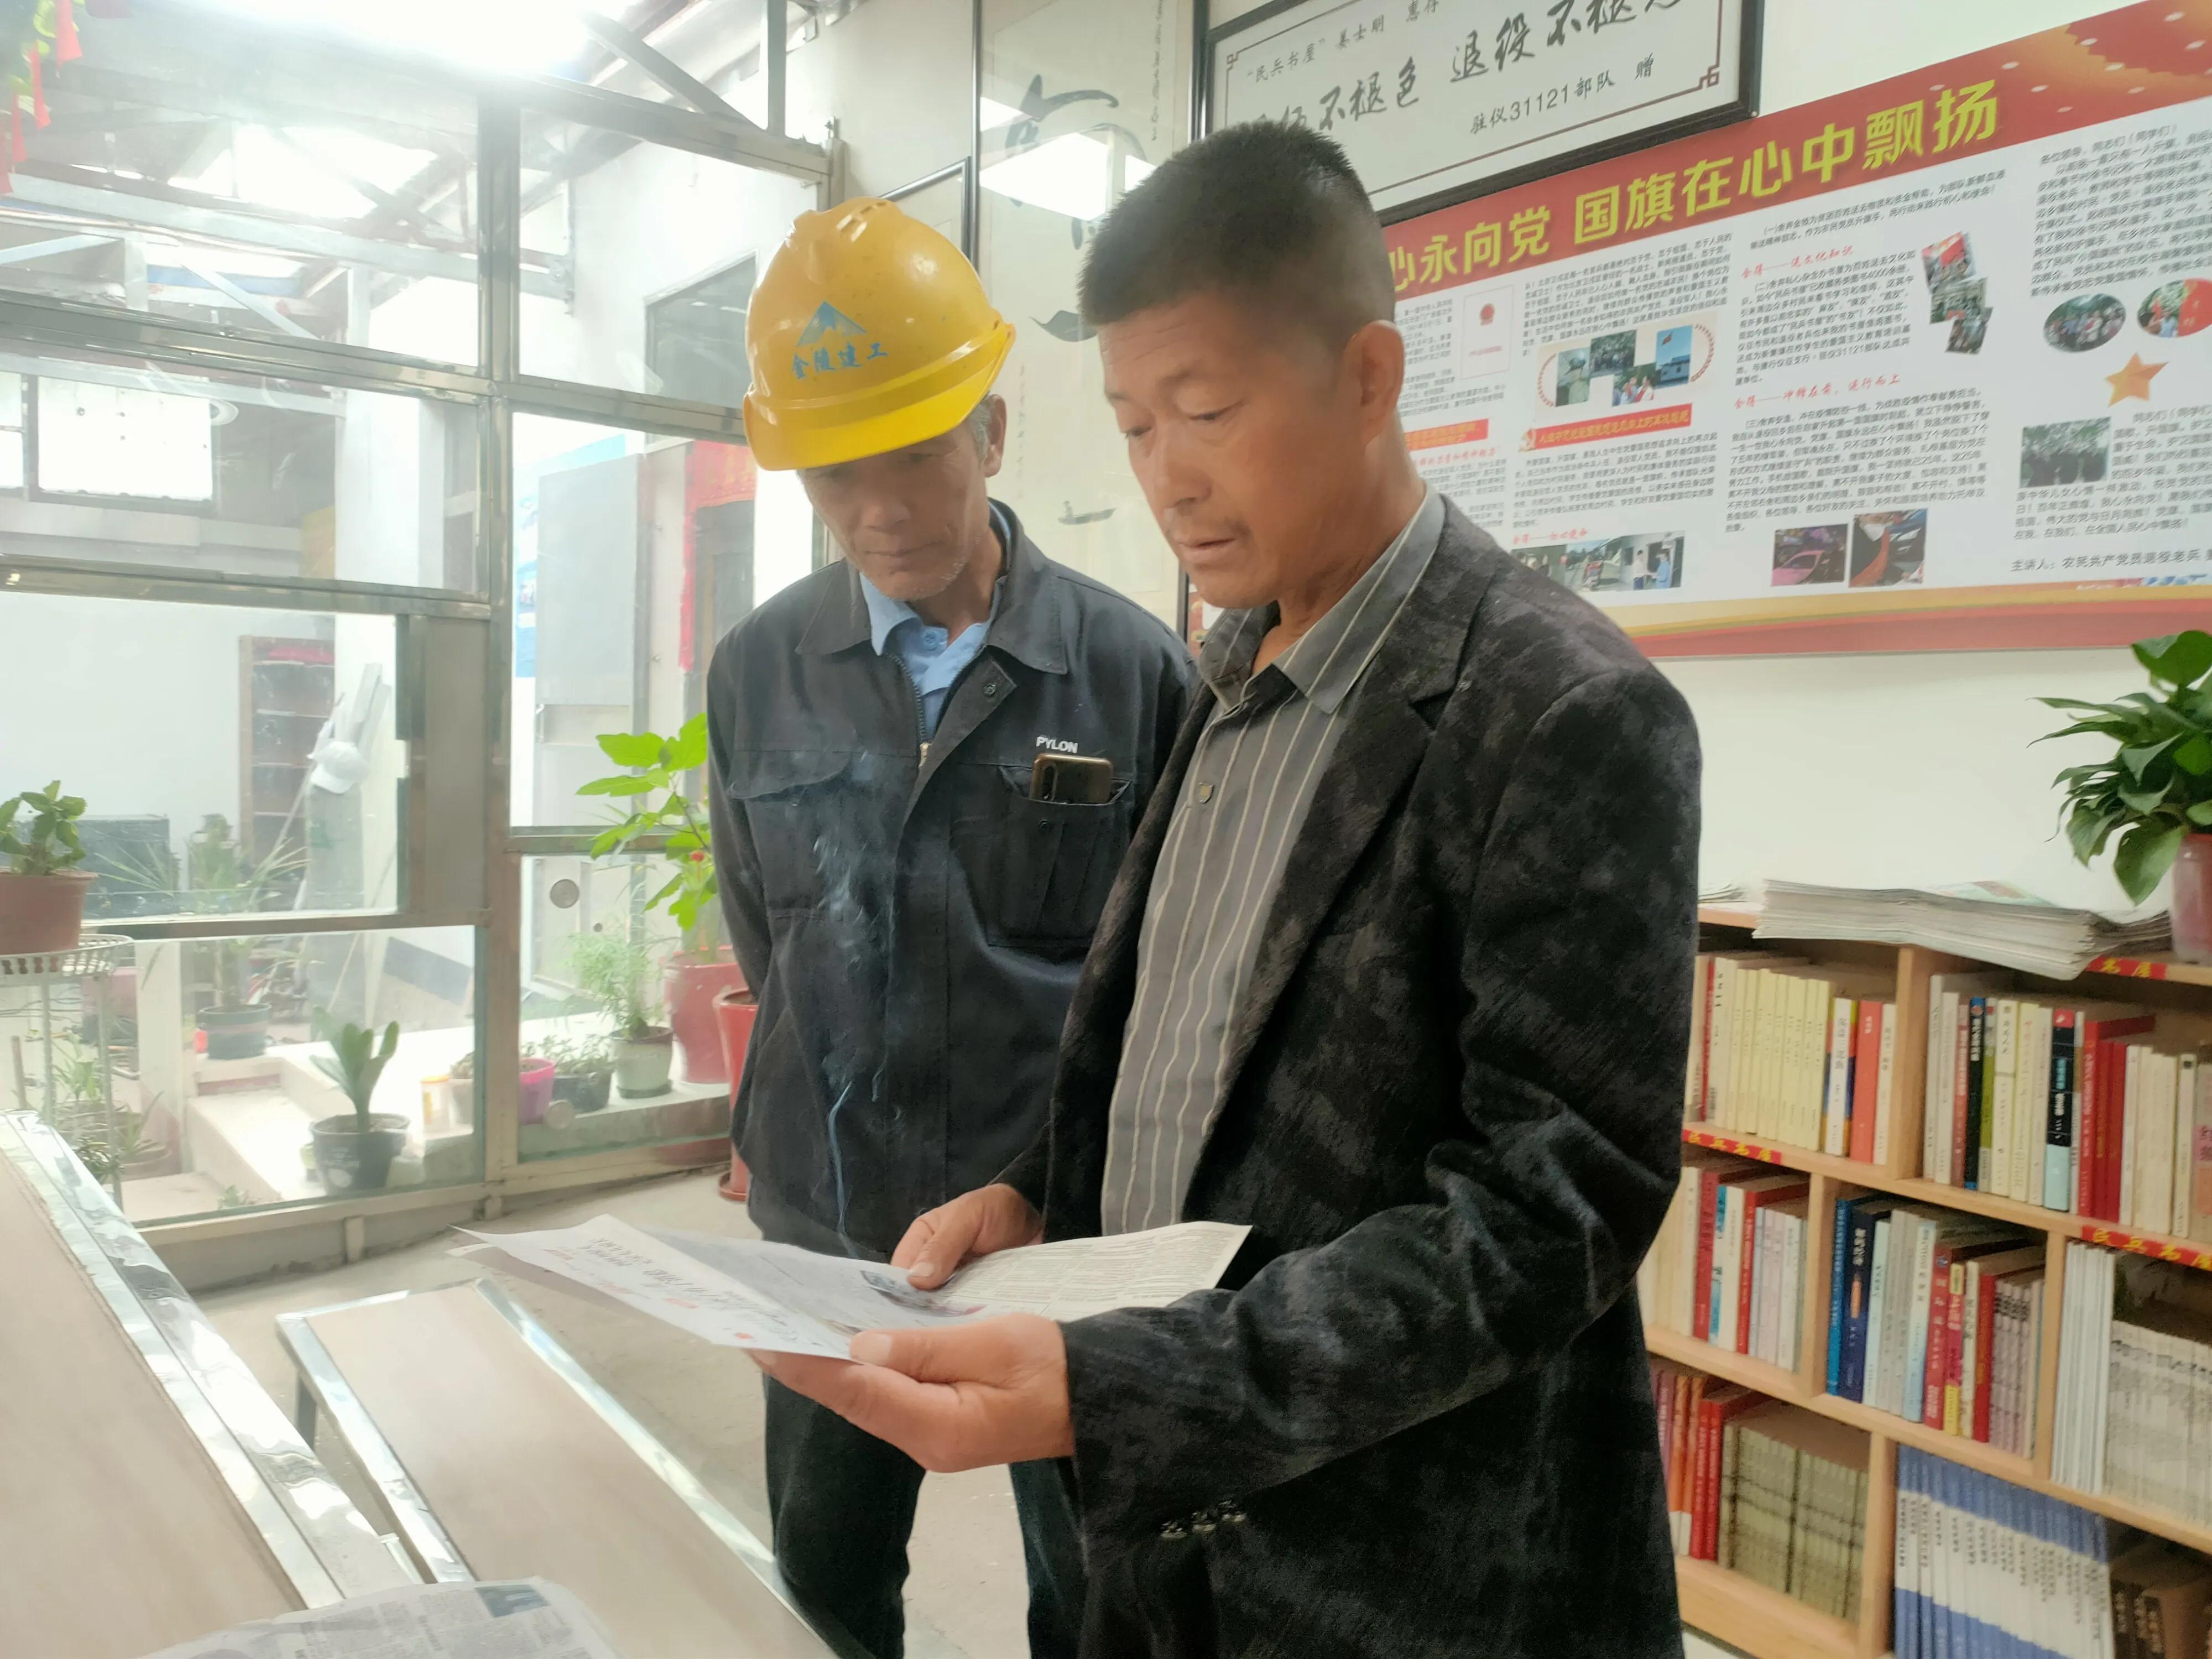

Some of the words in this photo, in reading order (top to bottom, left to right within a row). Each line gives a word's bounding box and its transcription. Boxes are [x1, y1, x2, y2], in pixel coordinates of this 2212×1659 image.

[1573, 79, 1999, 245] 国旗在心中飘扬
[1035, 736, 1078, 754] PYLON
